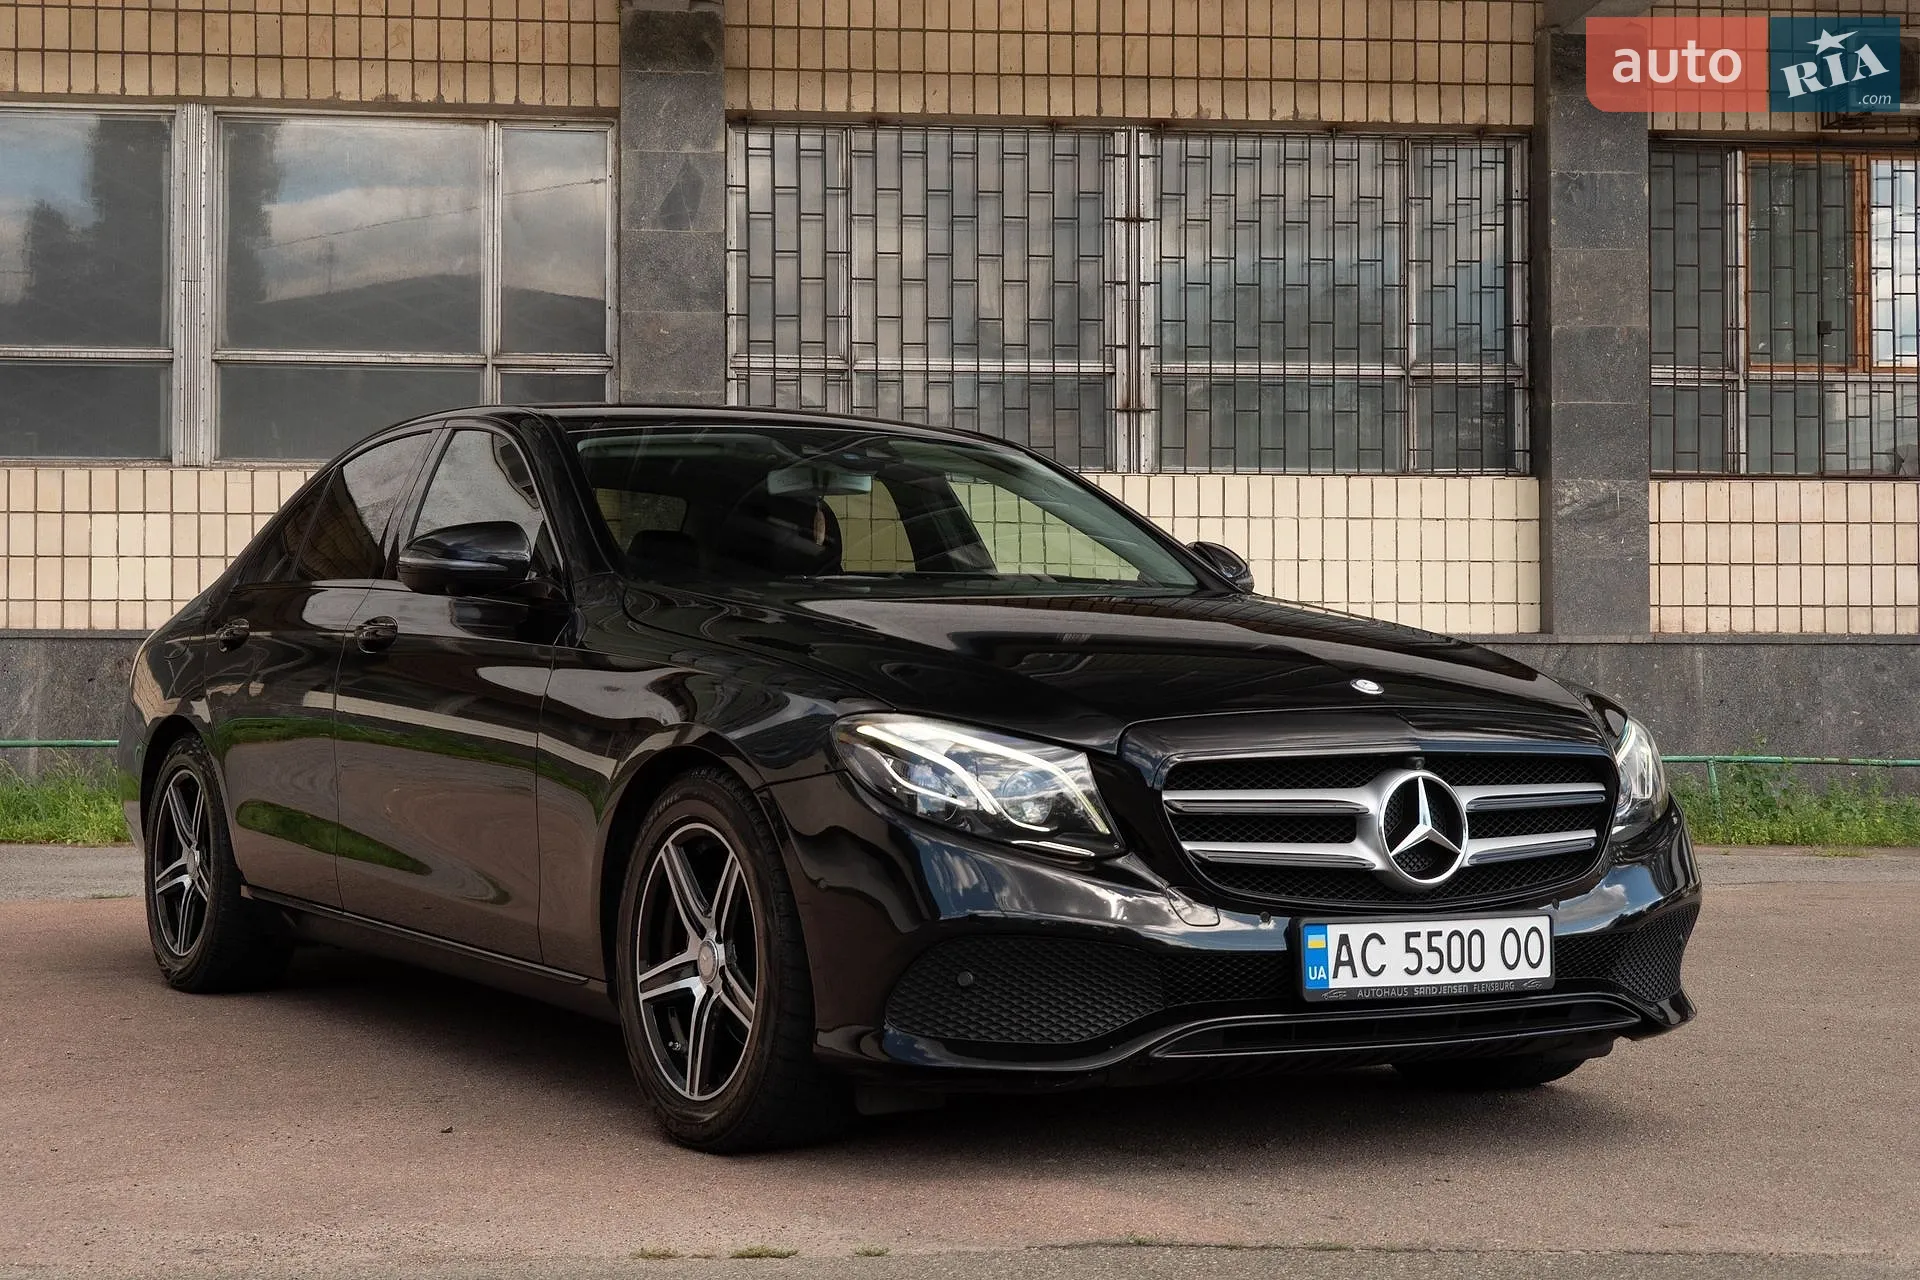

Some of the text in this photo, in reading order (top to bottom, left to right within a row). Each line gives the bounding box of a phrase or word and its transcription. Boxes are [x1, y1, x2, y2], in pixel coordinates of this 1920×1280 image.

[1332, 932, 1387, 979] AC
[1404, 929, 1485, 976] 5500
[1308, 966, 1327, 980] UA
[1357, 987, 1409, 998] AUTOHAUS
[1473, 981, 1515, 993] FLENSBURG
